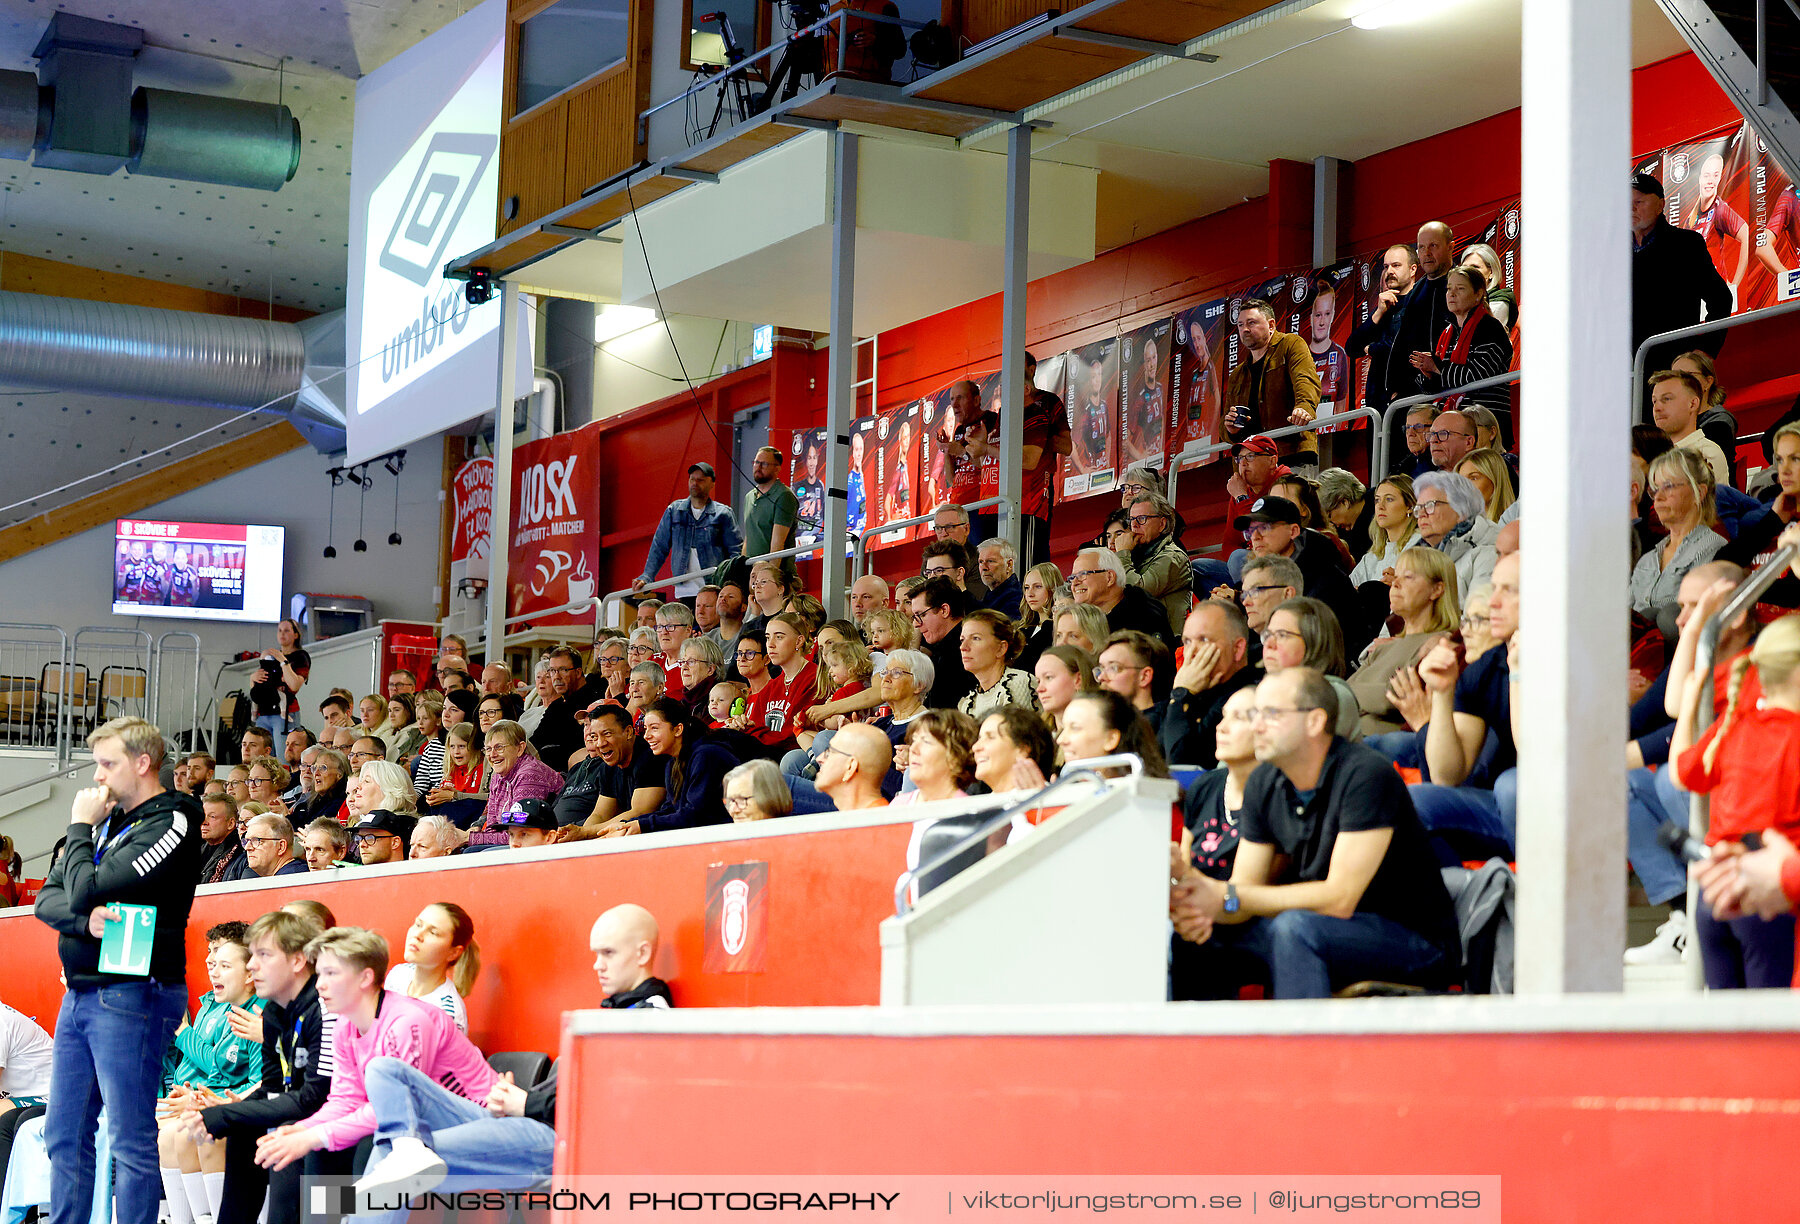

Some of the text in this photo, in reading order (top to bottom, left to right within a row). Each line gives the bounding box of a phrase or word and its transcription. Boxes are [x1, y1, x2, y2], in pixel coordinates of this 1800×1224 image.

[1756, 166, 1767, 247] 99 MELINA PILAV
[1505, 250, 1514, 291] RIKSSON
[1205, 304, 1225, 318] SHE
[1361, 301, 1369, 323] OLM
[382, 281, 470, 383] umbro
[1173, 374, 1181, 388] VAN
[1171, 389, 1180, 427] JAKOBSSON
[800, 500, 817, 517] 24
[134, 521, 180, 536] SKÖVDE HF
[198, 566, 243, 579] SKÖVDE HF
[104, 906, 146, 973] T
